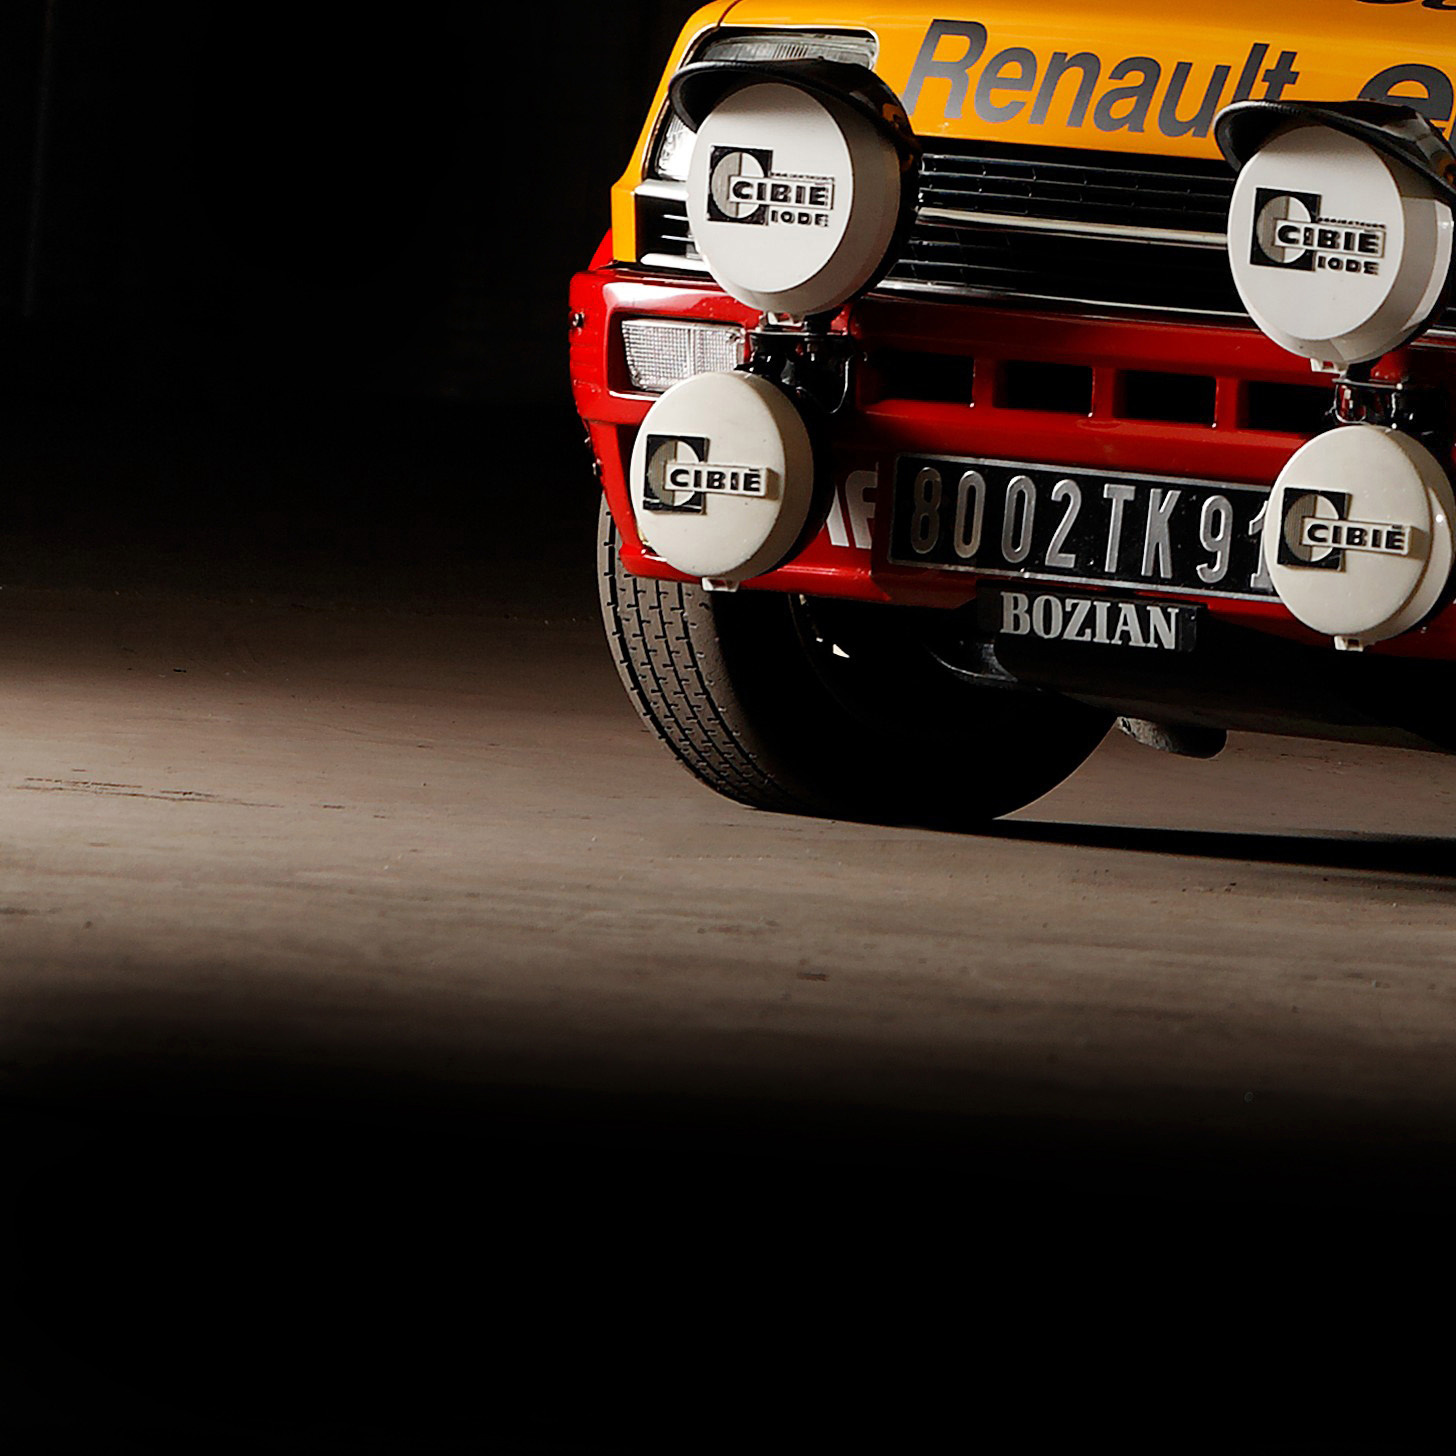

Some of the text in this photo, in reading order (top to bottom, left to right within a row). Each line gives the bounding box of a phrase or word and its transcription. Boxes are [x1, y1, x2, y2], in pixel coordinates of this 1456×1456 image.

[902, 18, 1300, 139] Renault
[771, 210, 829, 227] IODE
[1317, 255, 1380, 276] IODE
[910, 467, 1083, 568] 8002
[1101, 483, 1182, 578] TK
[1000, 591, 1179, 649] BOZIAN
